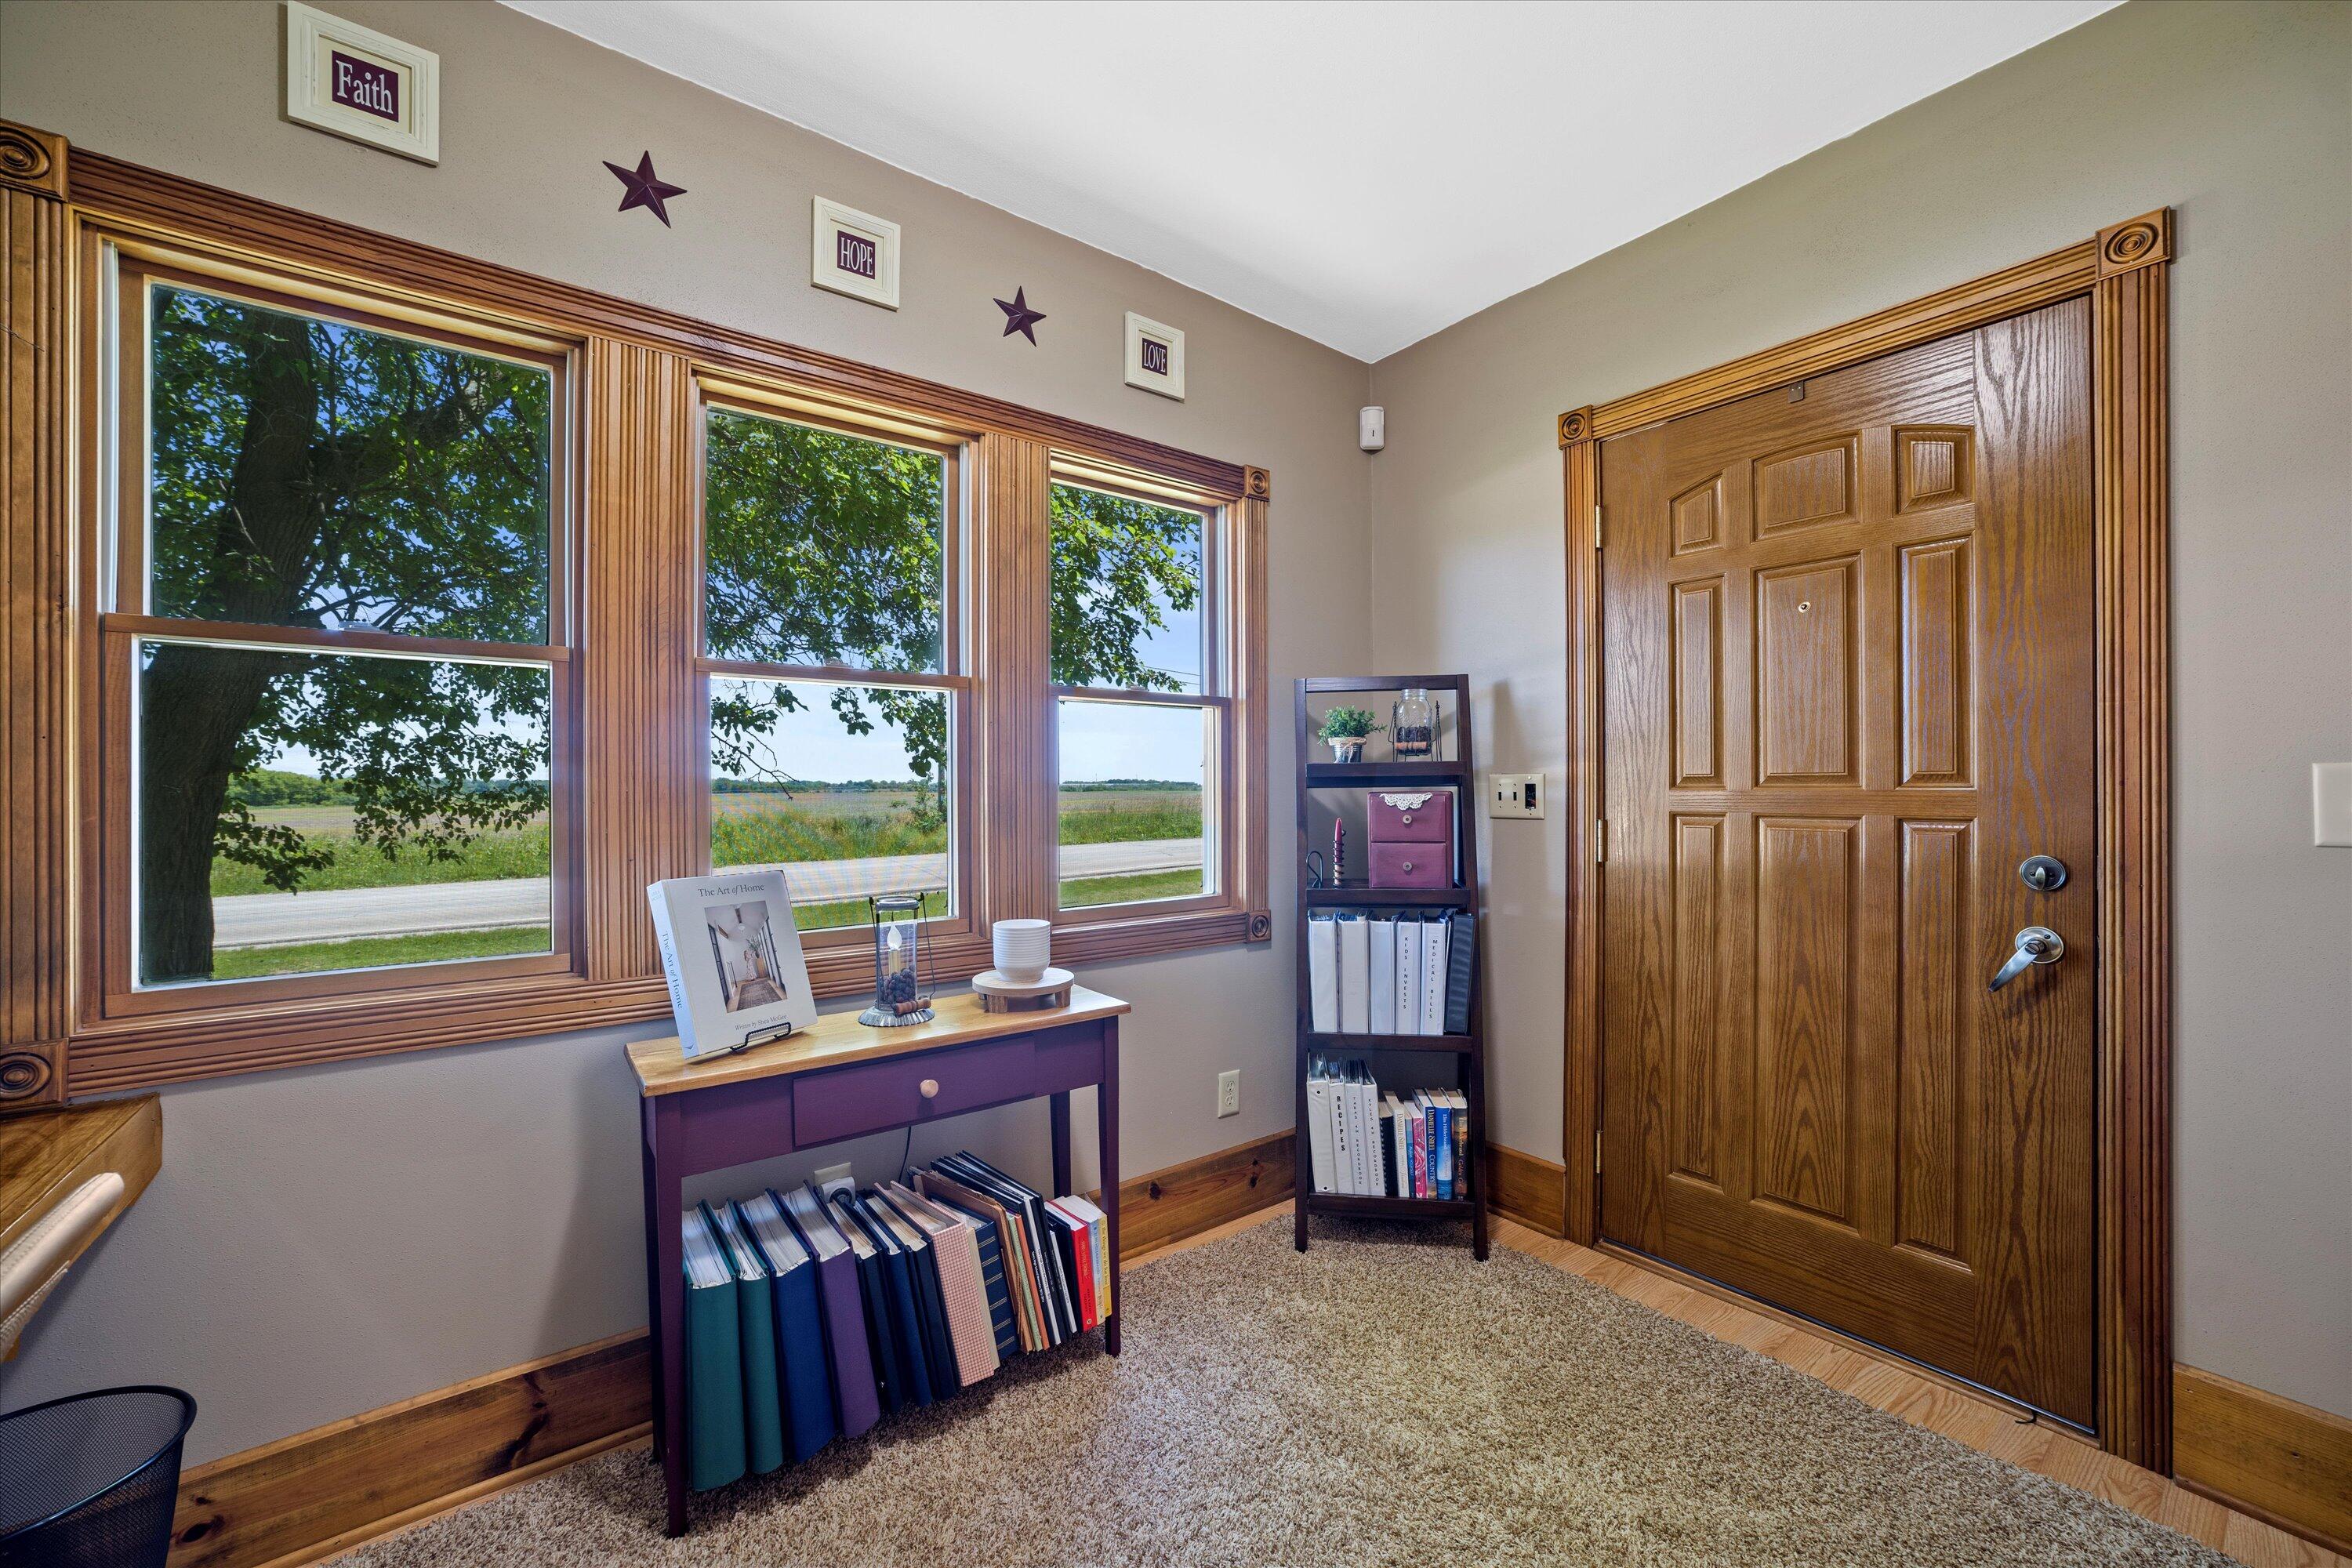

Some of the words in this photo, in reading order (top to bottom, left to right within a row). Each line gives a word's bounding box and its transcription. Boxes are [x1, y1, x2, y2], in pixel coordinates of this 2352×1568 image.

[336, 59, 394, 114] Faith
[840, 237, 873, 275] HOPE
[1144, 343, 1166, 372] LOVE
[697, 887, 715, 897] The
[717, 887, 730, 895] Art
[731, 884, 740, 895] of
[740, 884, 765, 893] Home
[661, 931, 670, 951] The
[666, 951, 675, 969] Art
[670, 968, 677, 978] of
[672, 978, 683, 1010] Home
[1337, 1095, 1345, 1152] RECIPES
[1396, 1113, 1404, 1134] DANIELLE
